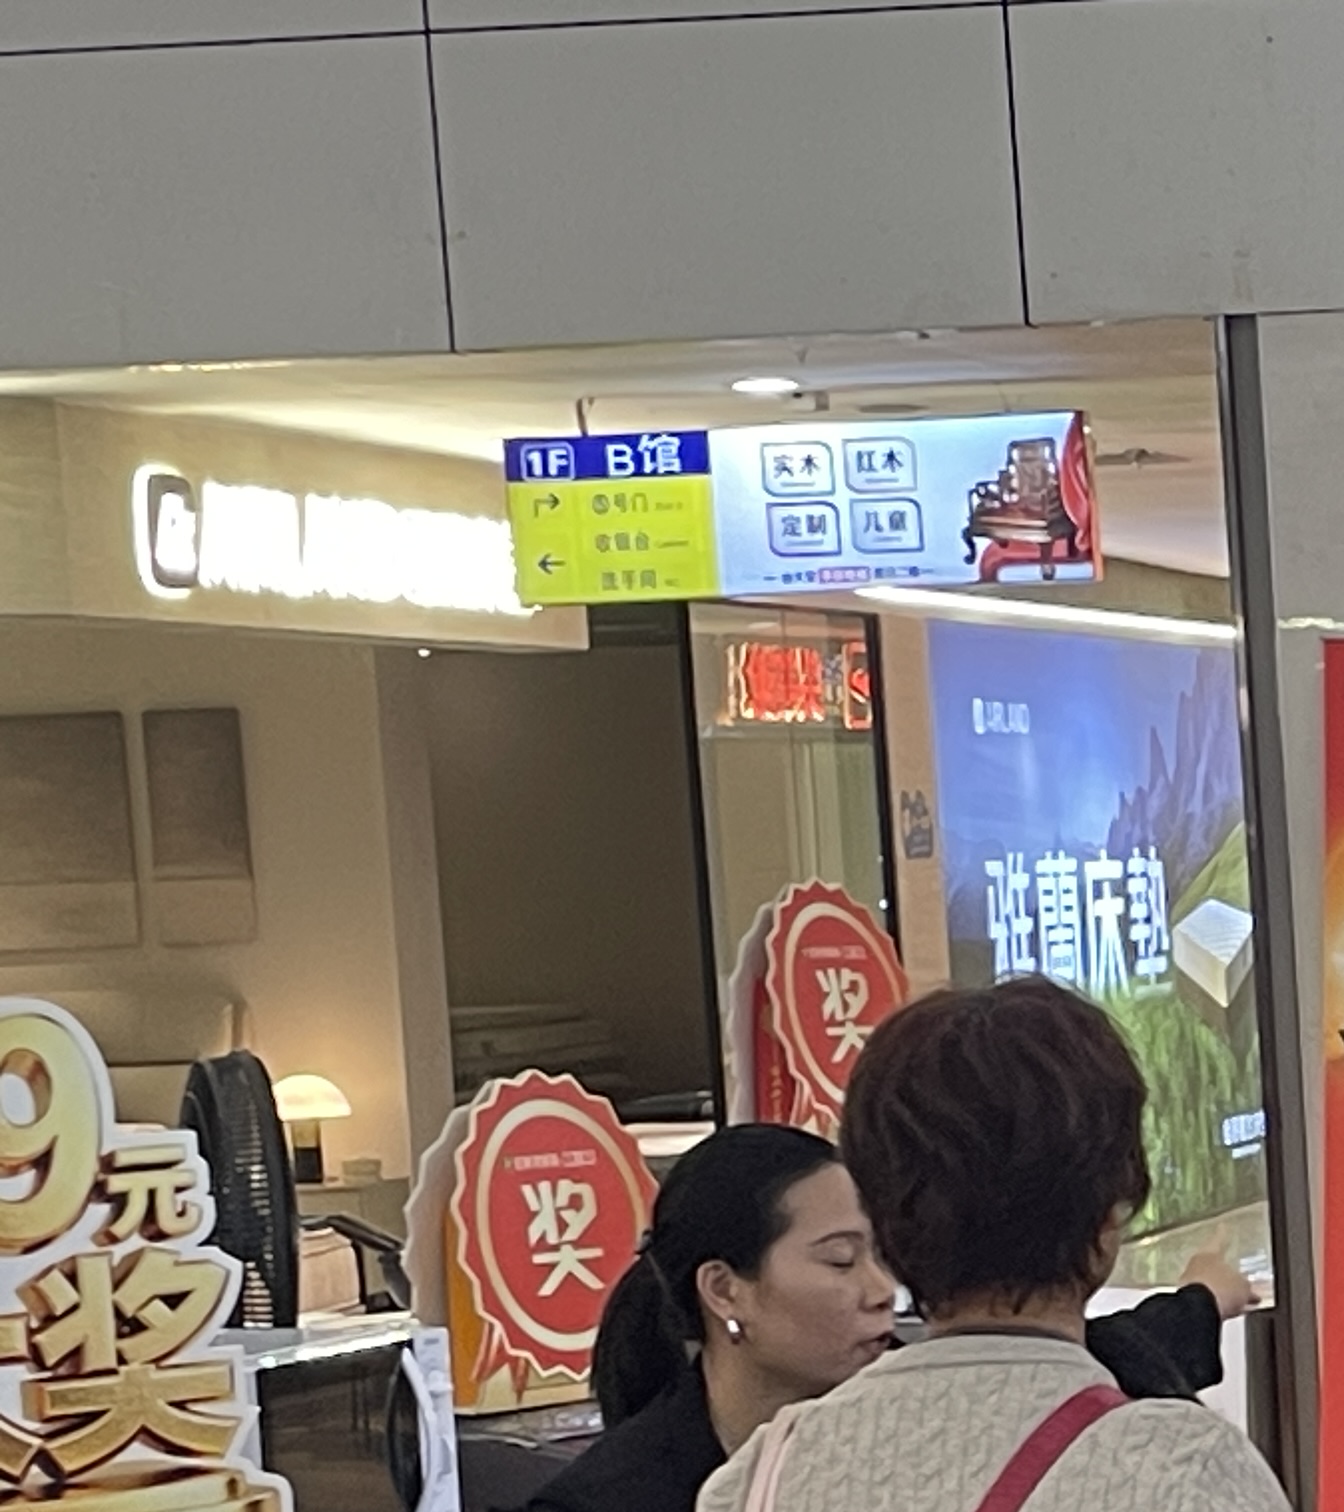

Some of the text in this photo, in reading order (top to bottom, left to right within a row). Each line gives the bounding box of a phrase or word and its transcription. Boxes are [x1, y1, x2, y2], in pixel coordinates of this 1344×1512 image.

[526, 448, 569, 478] 1F
[605, 433, 683, 477] B馆
[773, 453, 821, 479] 实木
[856, 446, 905, 473] 红木
[781, 513, 827, 537] 定制
[814, 967, 876, 1064] 奖
[521, 1178, 605, 1296] 奖
[0, 1248, 242, 1486] 奖
